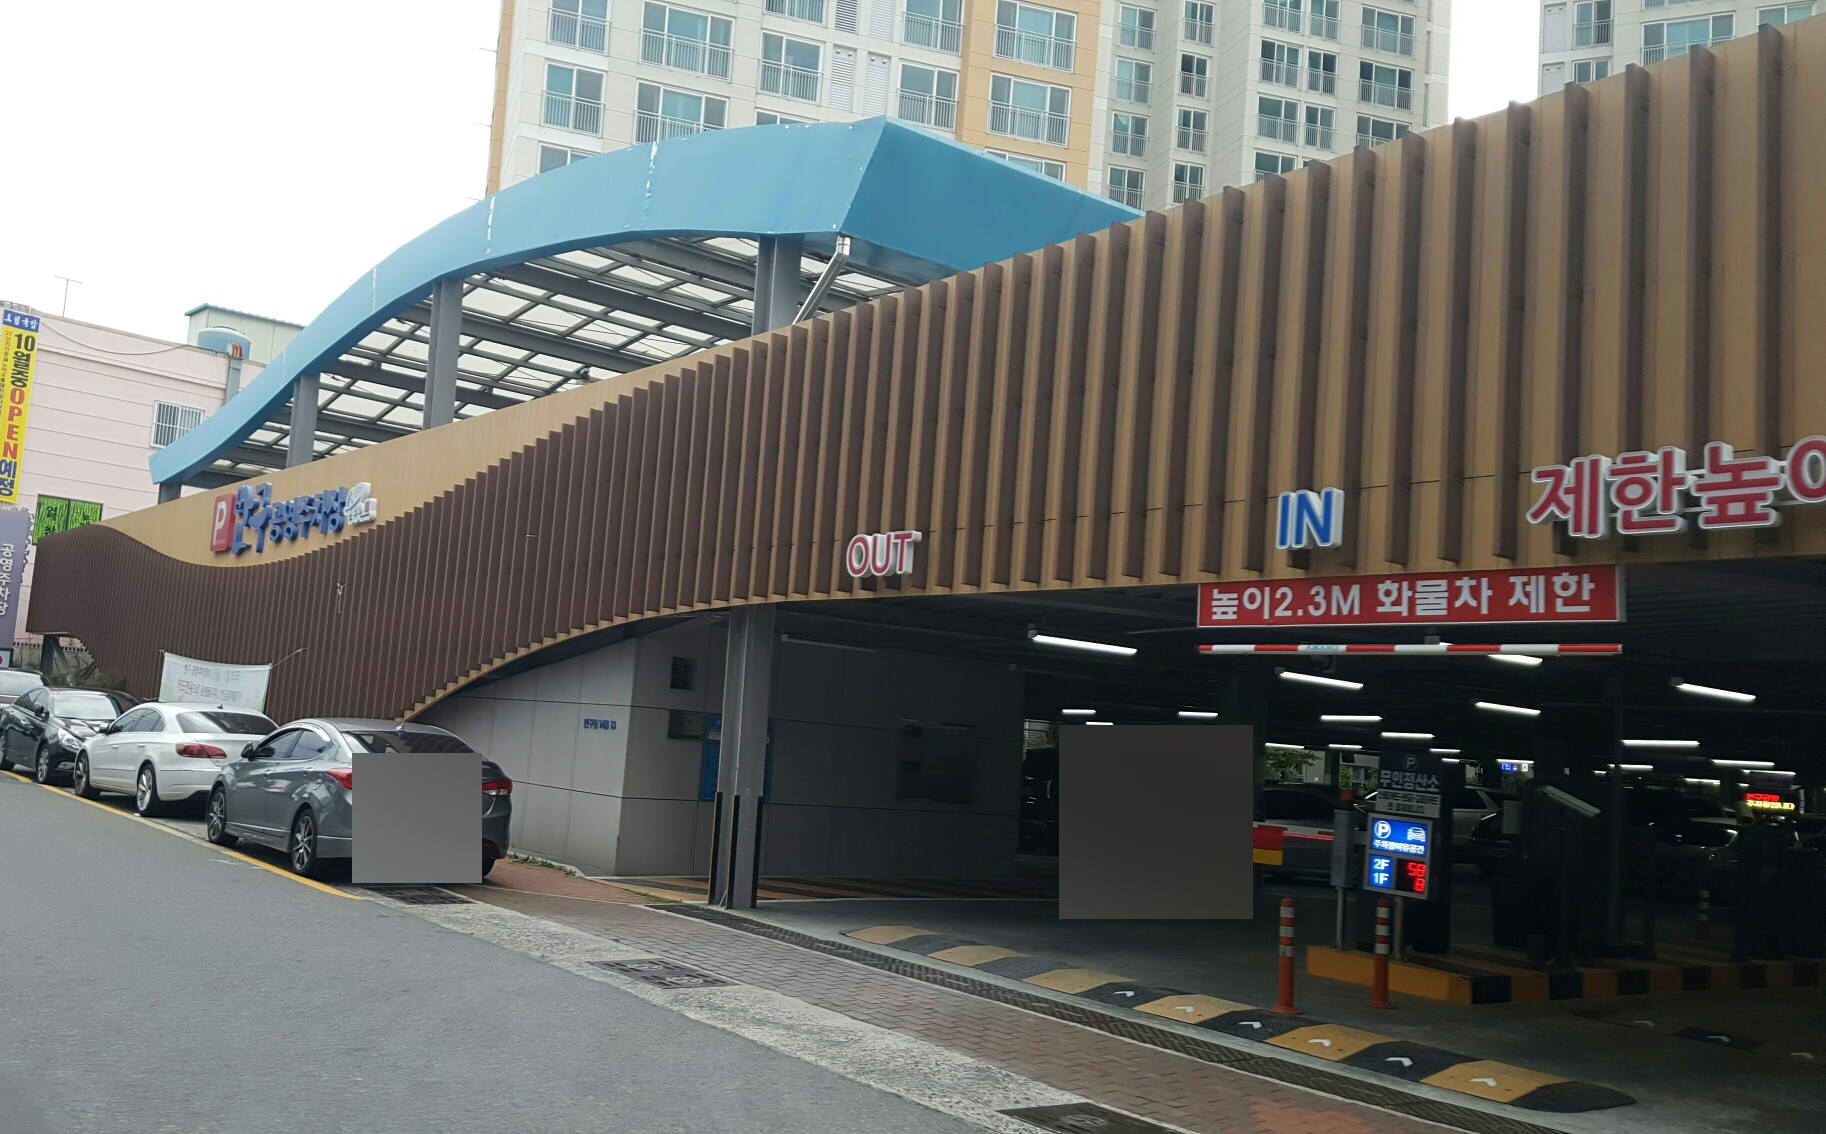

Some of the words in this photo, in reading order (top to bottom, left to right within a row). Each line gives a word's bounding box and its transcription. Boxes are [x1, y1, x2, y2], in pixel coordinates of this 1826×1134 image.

[1276, 487, 1345, 549] IN
[846, 530, 922, 578] OUT
[1211, 584, 1361, 620] 높이2.3M
[1376, 576, 1493, 617] 화물차
[1509, 571, 1597, 615] 제한
[1379, 769, 1440, 793] 무인정산소
[1373, 858, 1390, 870] 2F
[1373, 872, 1390, 885] 1F
